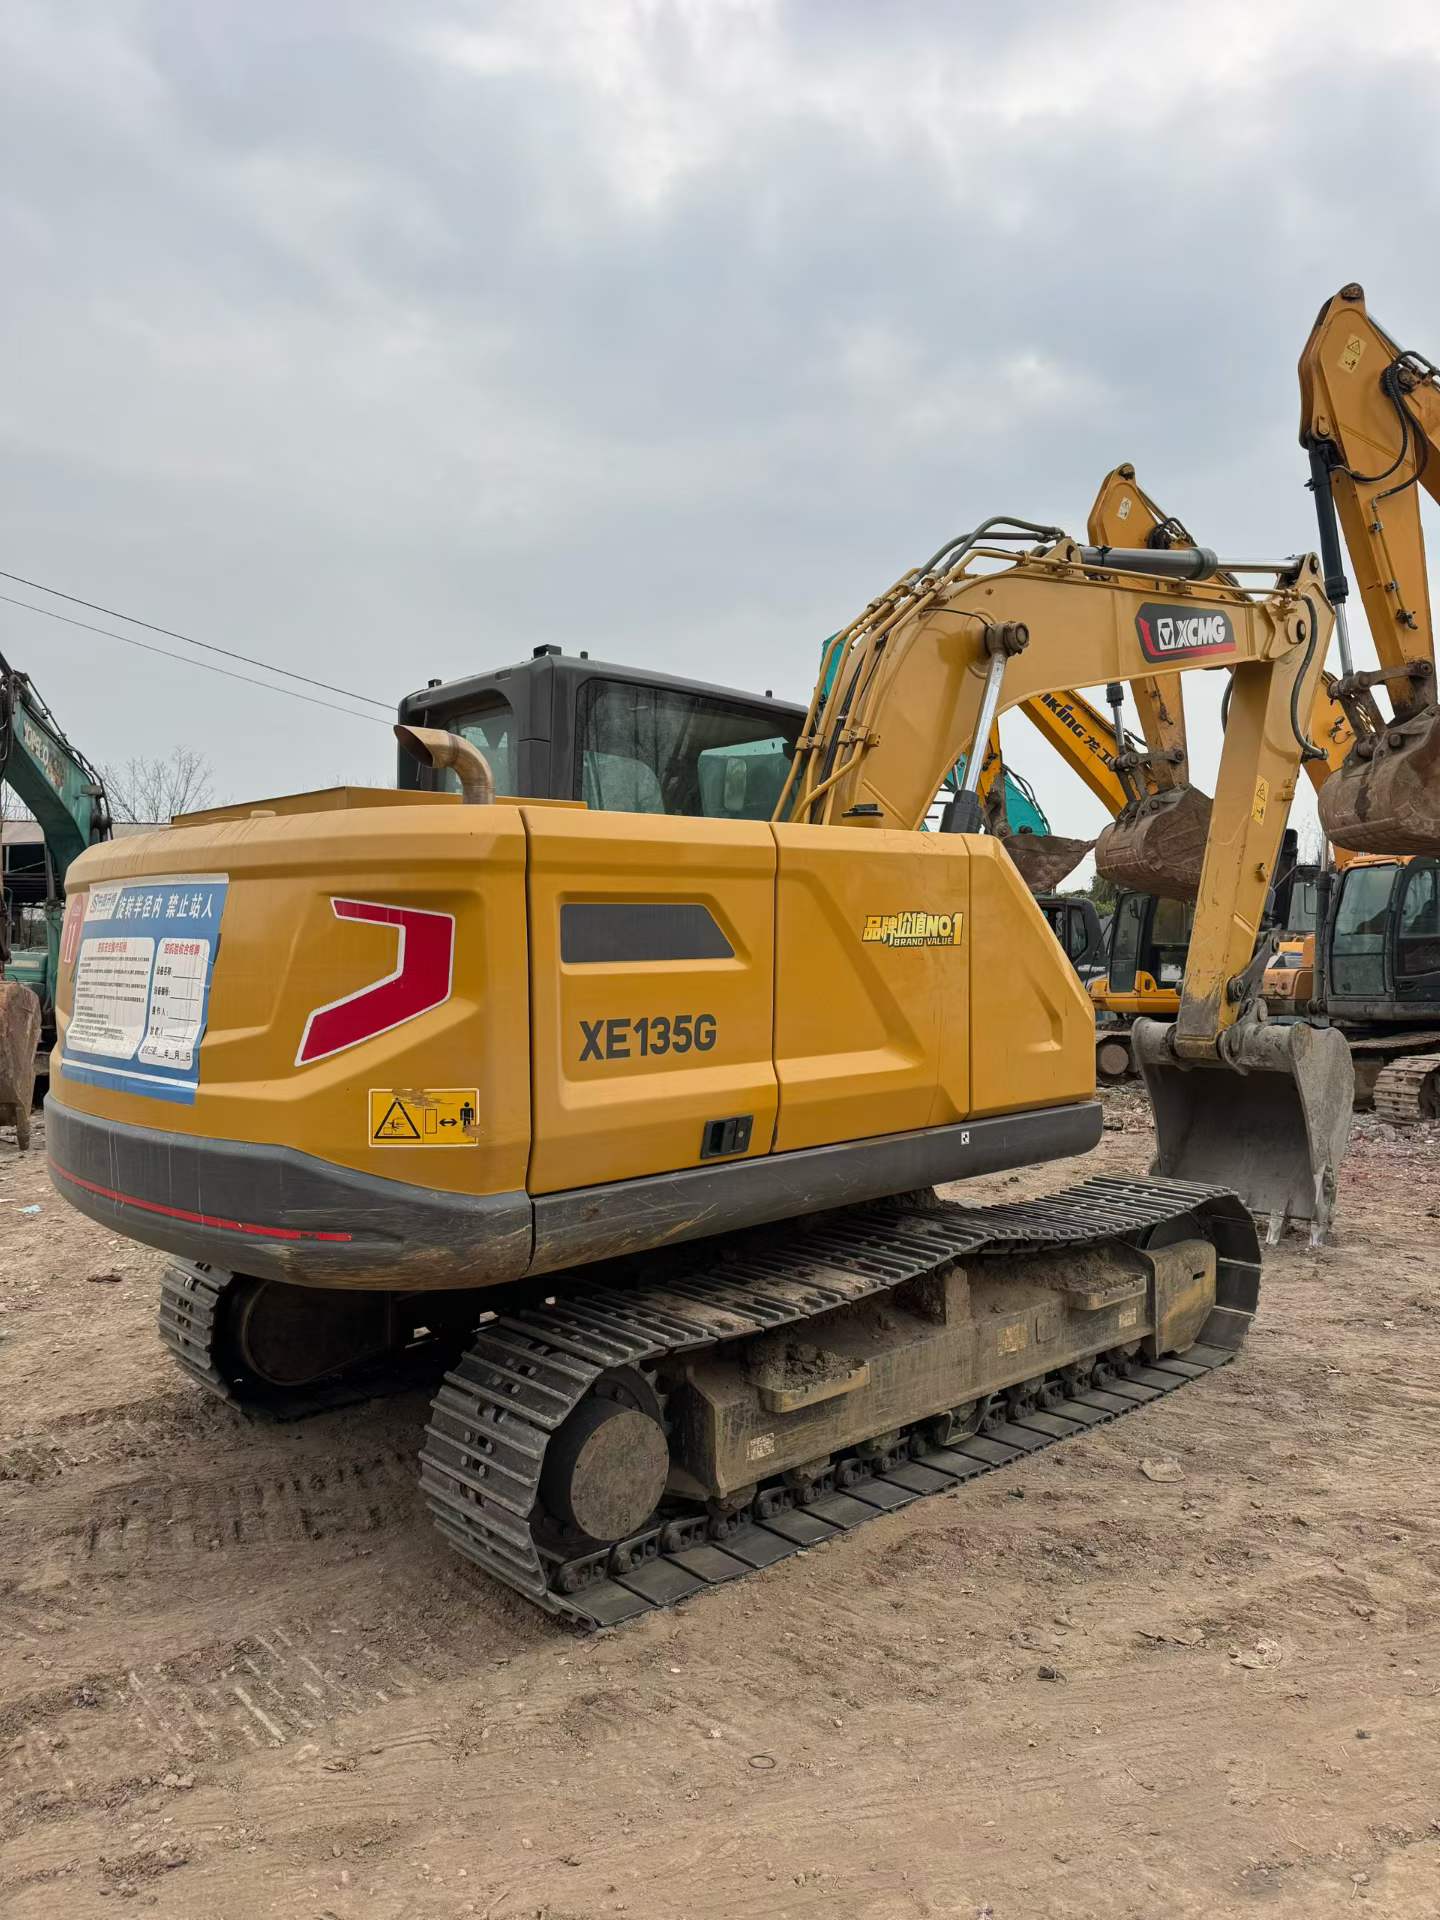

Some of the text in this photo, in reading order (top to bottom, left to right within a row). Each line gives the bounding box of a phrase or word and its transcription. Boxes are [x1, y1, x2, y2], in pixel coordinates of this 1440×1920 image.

[1175, 615, 1226, 647] XCMG
[115, 895, 163, 920] 旋转半径内
[165, 893, 213, 918] 禁止站人
[893, 936, 953, 946] BRAND VALUE
[579, 1014, 717, 1062] XE135G
